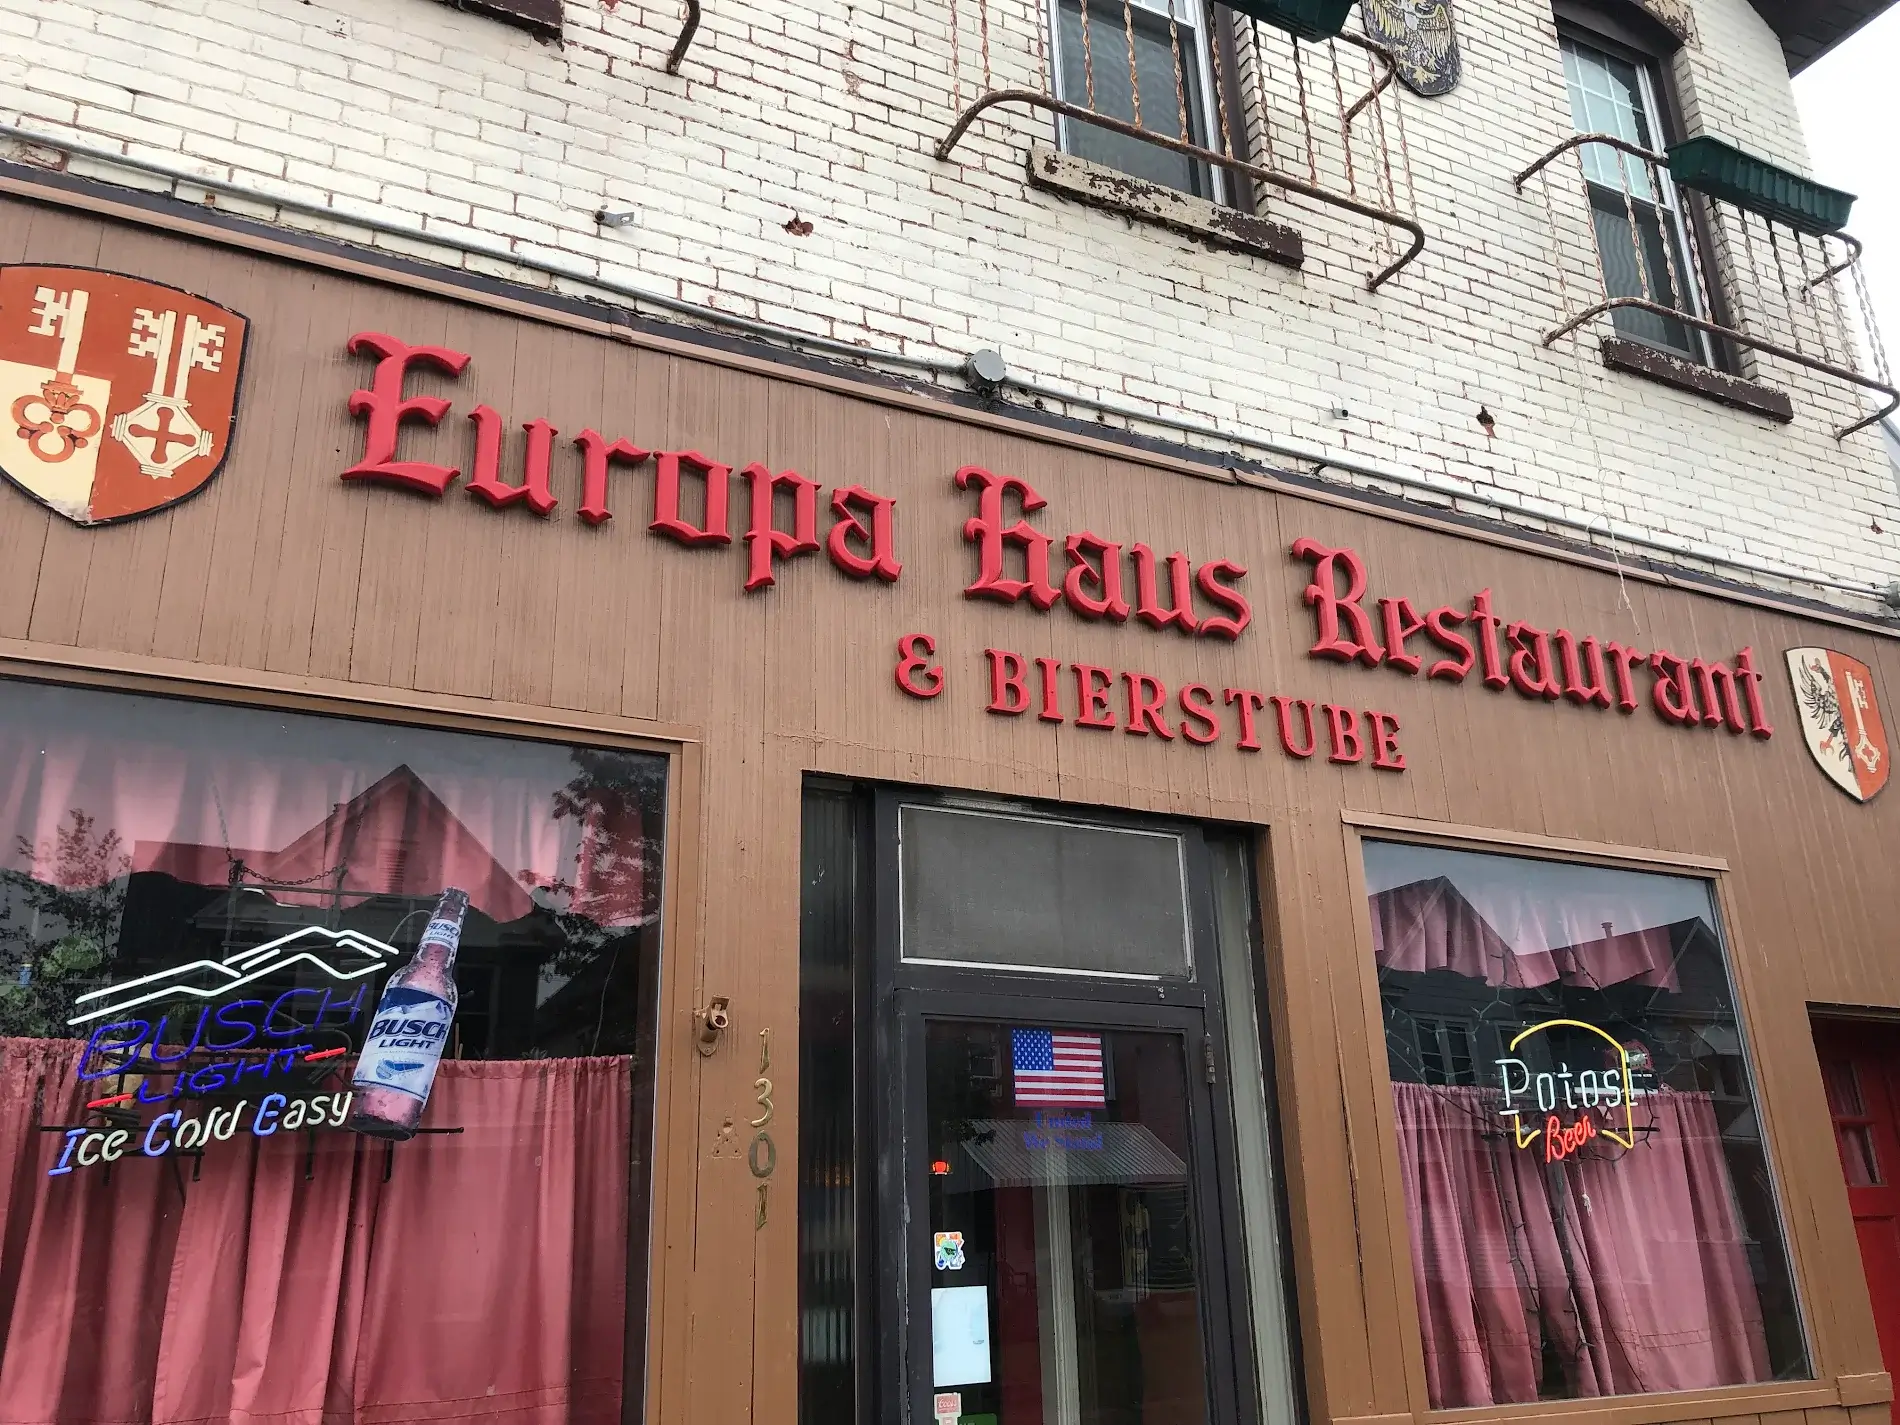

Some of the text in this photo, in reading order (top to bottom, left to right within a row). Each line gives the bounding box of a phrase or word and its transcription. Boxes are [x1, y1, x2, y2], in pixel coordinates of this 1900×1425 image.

[340, 331, 1774, 740] Europa Haus Restaurant
[894, 632, 1407, 773] & BIERSTUBE
[78, 983, 368, 1081] BUSCH
[368, 1018, 450, 1042] BUSCH
[378, 1037, 436, 1050] LIGHT
[138, 1044, 314, 1104] LIGHT
[48, 1090, 354, 1177] Ice Cold Easy
[748, 1026, 777, 1232] 1301
[1545, 1114, 1597, 1163] Beer
